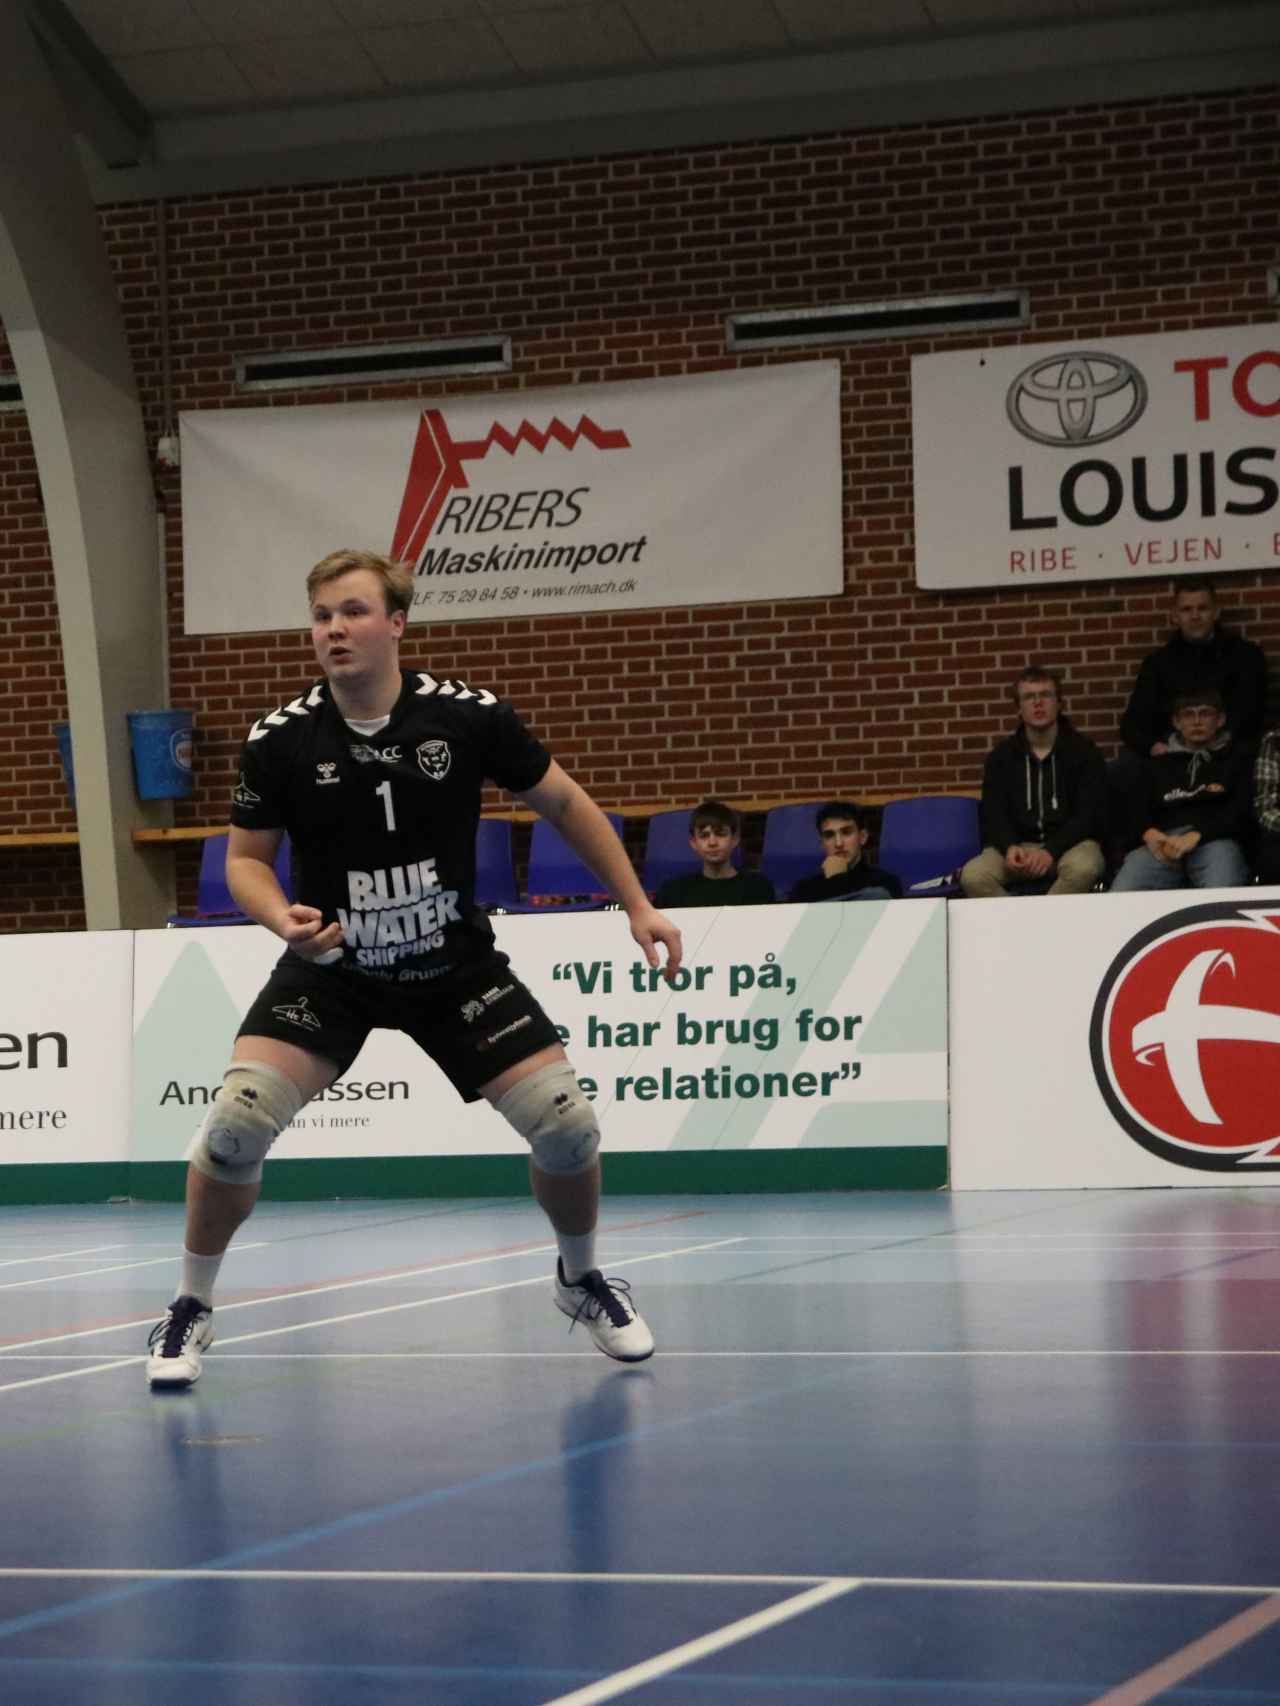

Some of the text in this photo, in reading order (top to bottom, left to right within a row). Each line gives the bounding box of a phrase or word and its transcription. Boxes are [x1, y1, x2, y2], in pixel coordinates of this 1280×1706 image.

[1008, 446, 1279, 531] LOUIS
[435, 487, 591, 535] RIBERS
[418, 536, 648, 577] Maskinimport
[1010, 538, 1222, 573] RIBE VEJEN
[438, 590, 457, 604] 75
[458, 588, 478, 602] 29
[479, 586, 497, 601] 84
[500, 585, 520, 600] 58
[532, 578, 638, 599] www.rimach.dk
[376, 781, 396, 831] 1
[347, 857, 442, 912] BLUE
[336, 890, 462, 949] WATER
[356, 930, 445, 967] SHIPPING
[552, 952, 797, 997] “Vi tror på,
[587, 1015, 661, 1048] har
[677, 1012, 779, 1051] brug
[795, 1008, 862, 1043] for
[616, 1062, 862, 1101] relationer”
[312, 1115, 325, 1129] vi
[330, 1115, 372, 1128] mere
